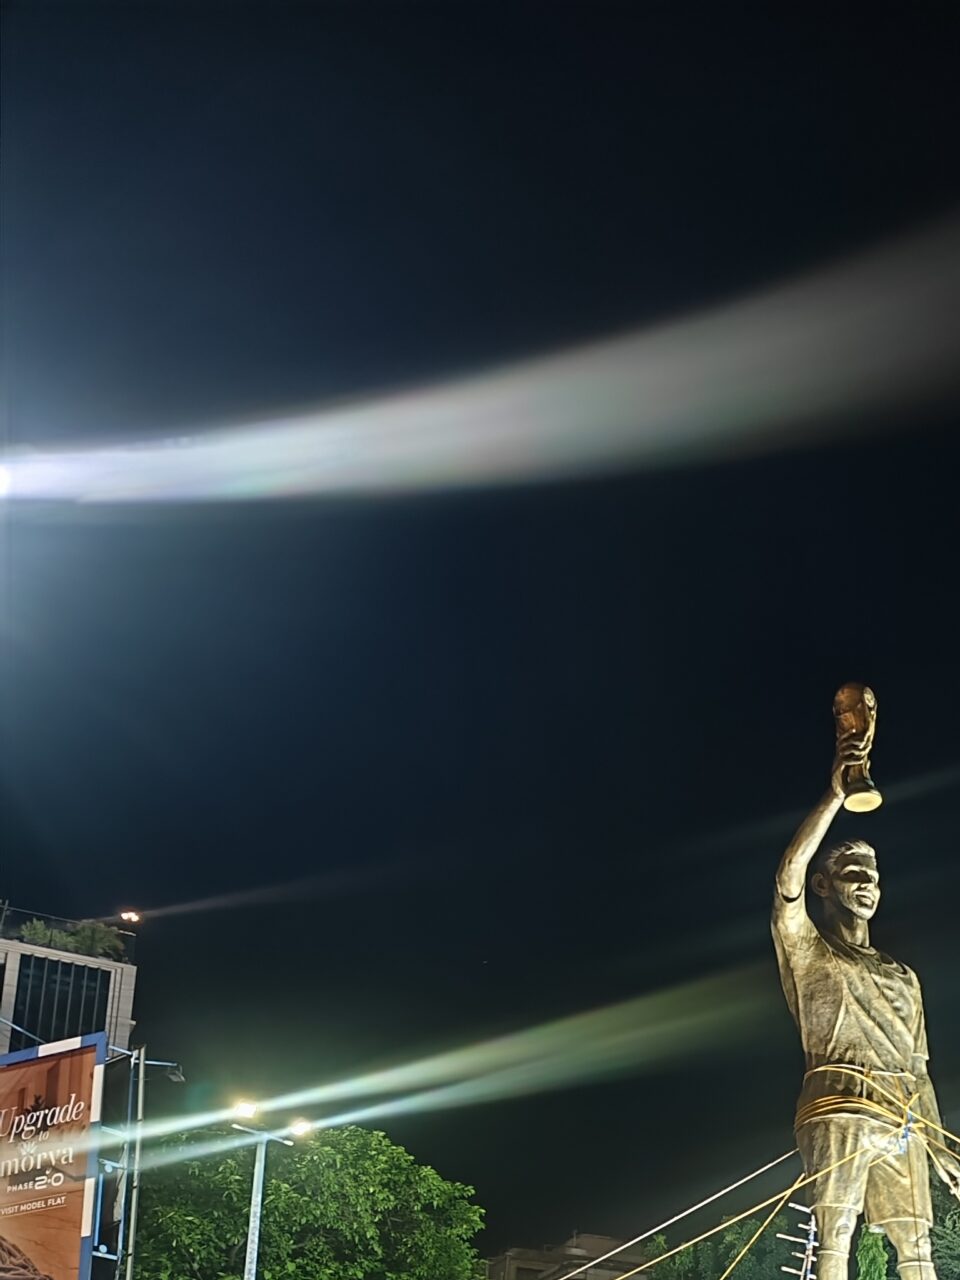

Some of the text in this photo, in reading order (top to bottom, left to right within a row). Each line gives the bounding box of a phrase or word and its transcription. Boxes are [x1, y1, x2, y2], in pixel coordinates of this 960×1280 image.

[0, 1093, 85, 1143] Upgrade
[39, 1130, 49, 1142] to
[7, 1181, 34, 1193] PHASE
[0, 1197, 67, 1215] VISIT MODEL FLAT
